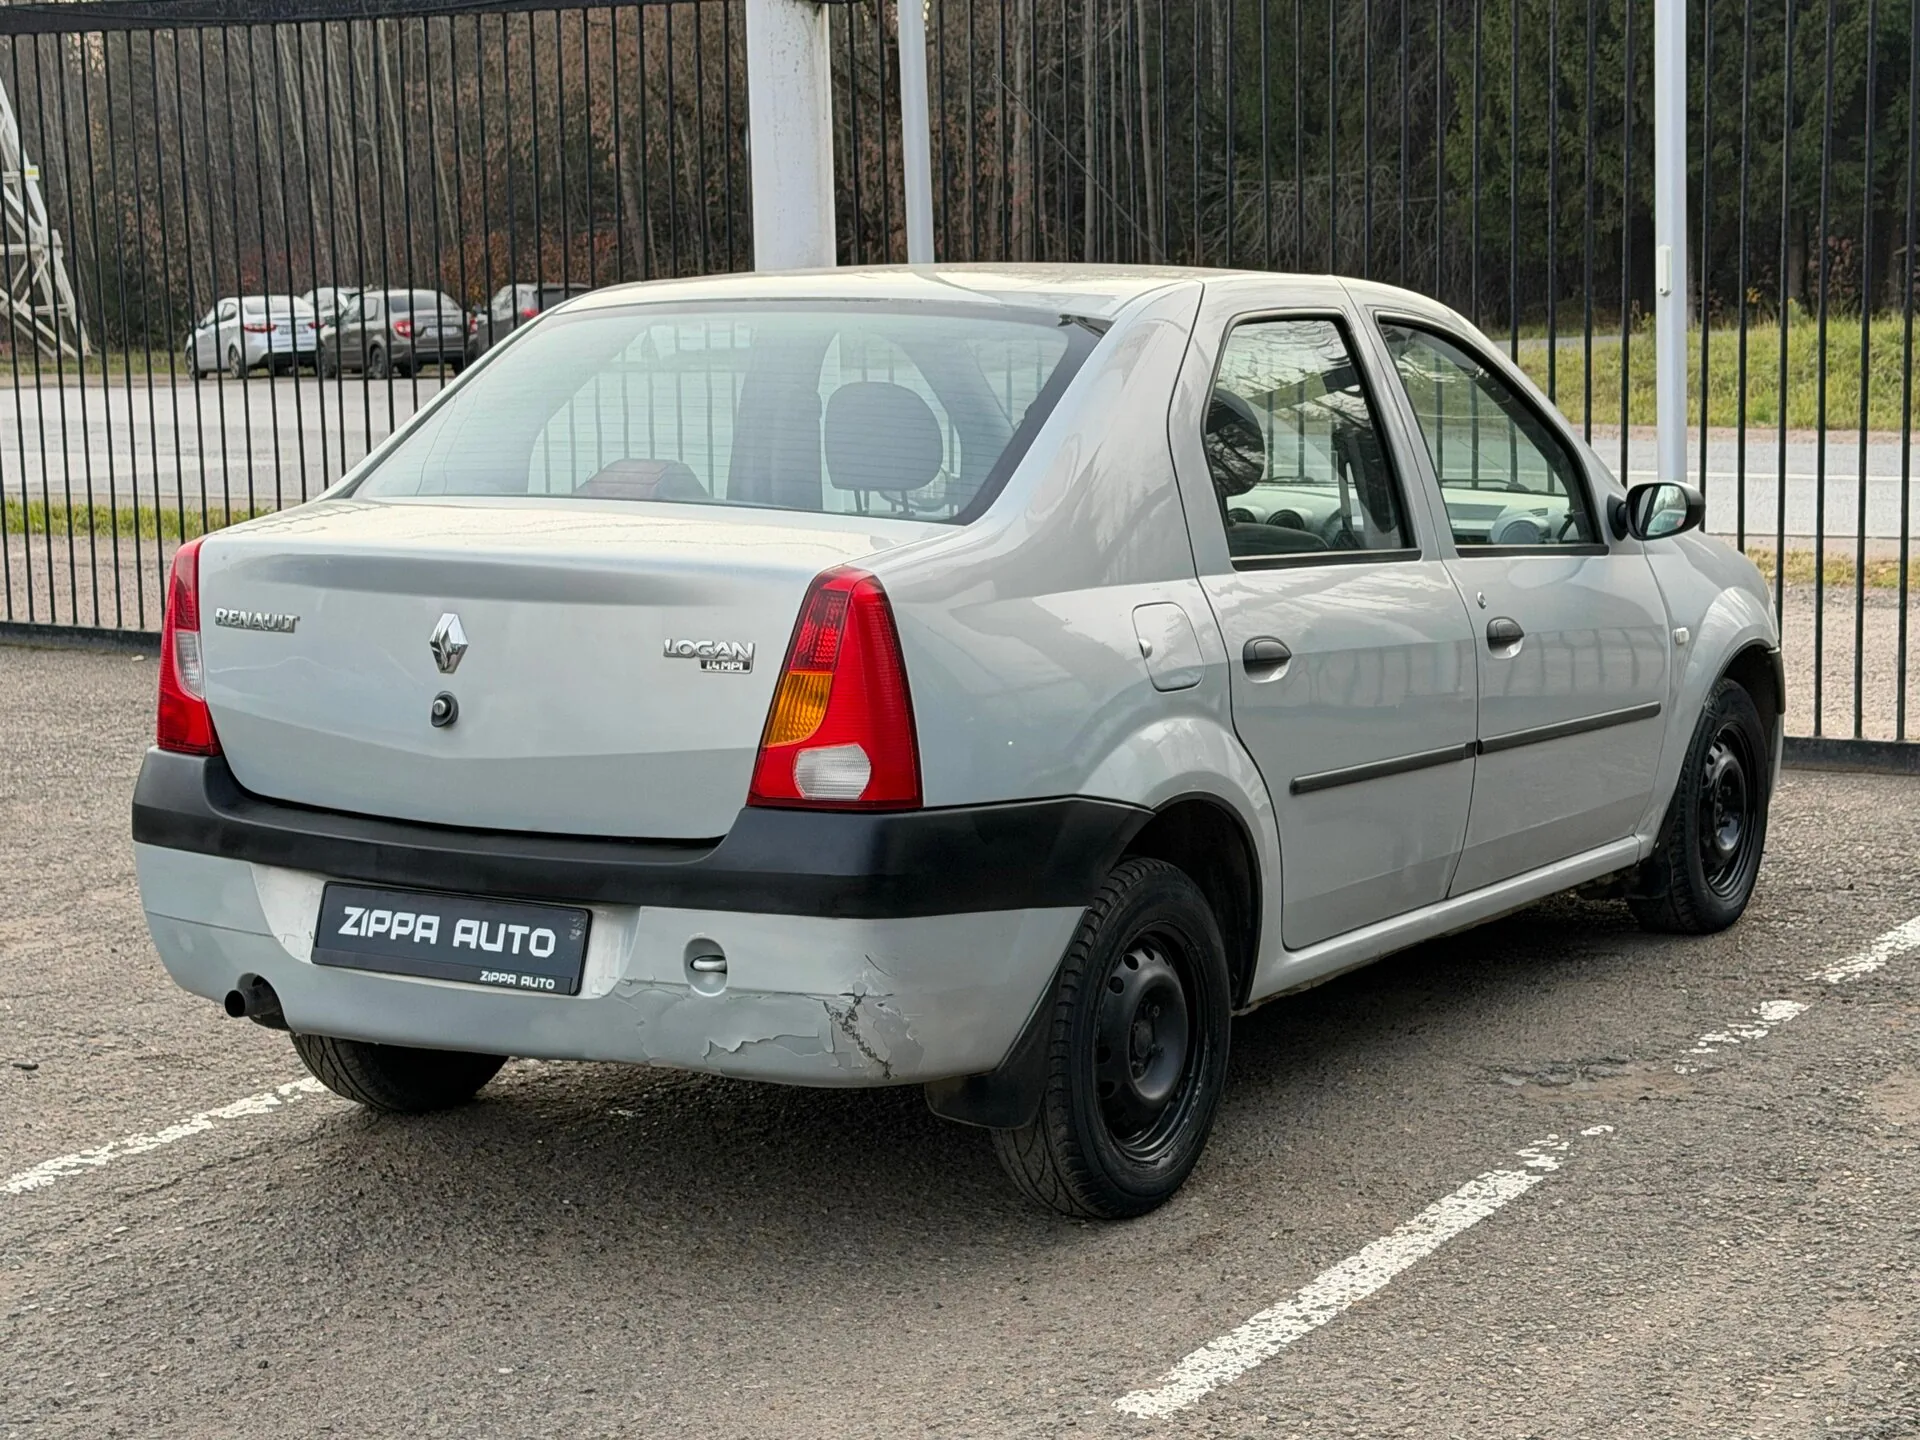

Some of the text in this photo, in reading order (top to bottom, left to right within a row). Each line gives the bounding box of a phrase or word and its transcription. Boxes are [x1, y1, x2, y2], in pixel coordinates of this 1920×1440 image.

[215, 607, 297, 632] RENAULT
[663, 639, 754, 660] LOGAN
[721, 661, 743, 671] MPI
[338, 906, 556, 958] ZIPPA AUTO
[521, 975, 555, 990] AUTO
